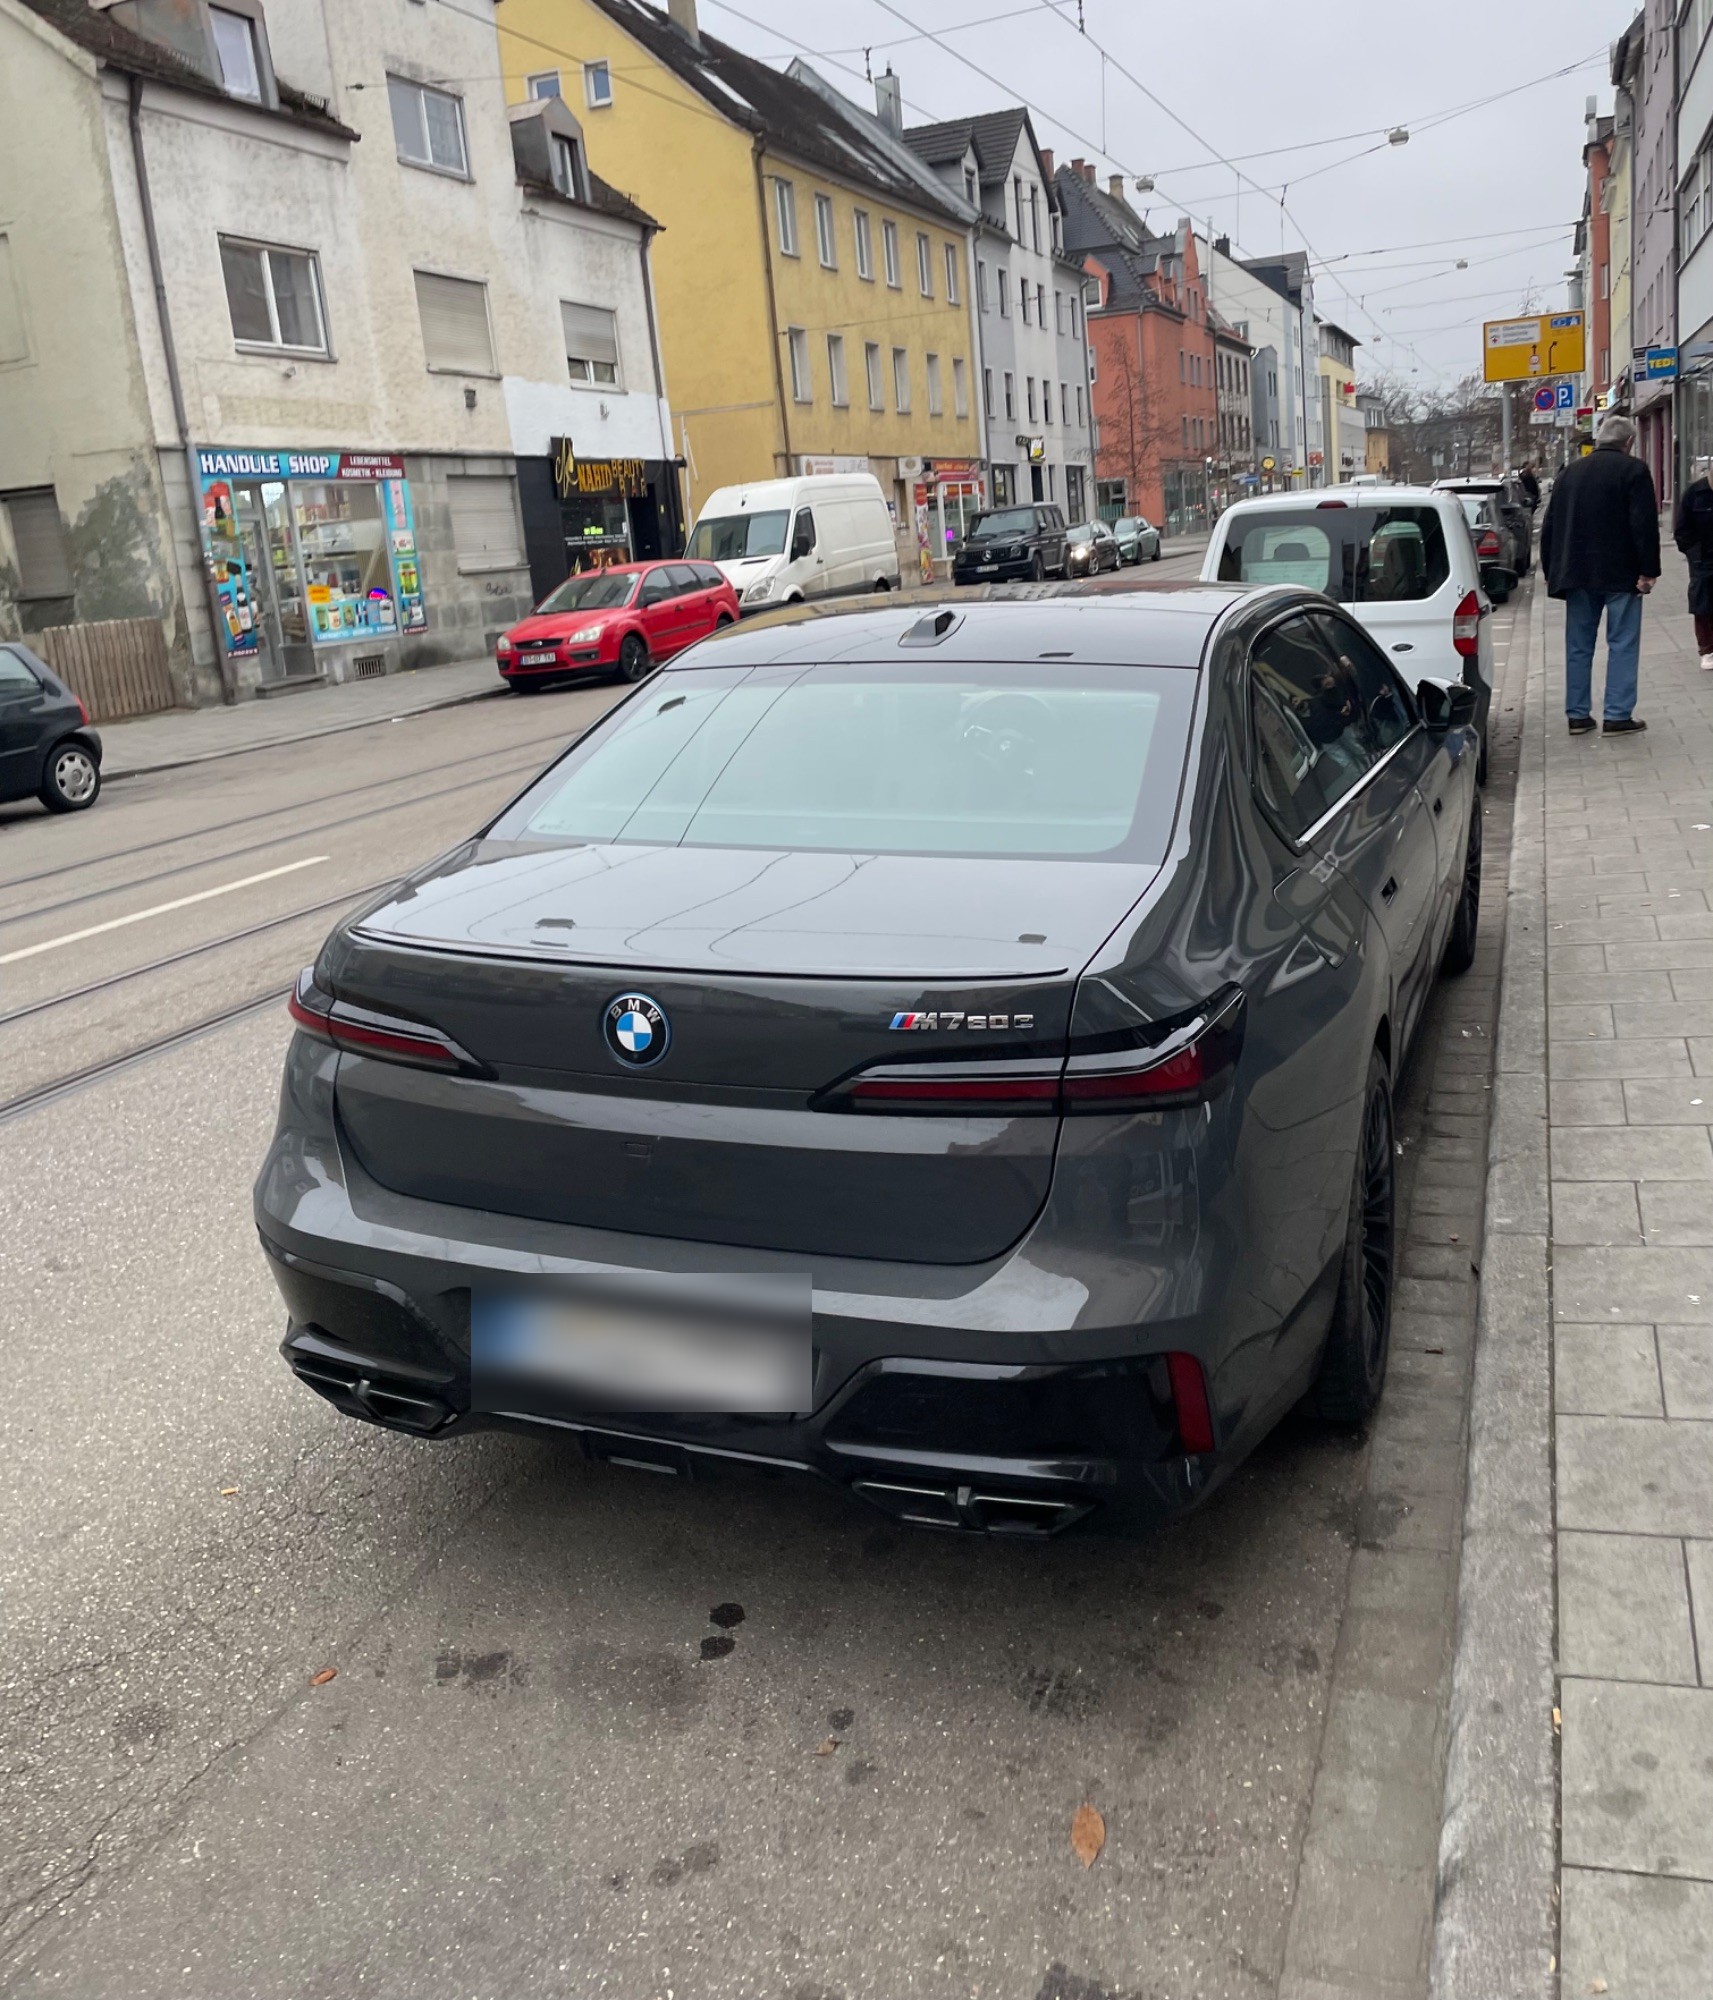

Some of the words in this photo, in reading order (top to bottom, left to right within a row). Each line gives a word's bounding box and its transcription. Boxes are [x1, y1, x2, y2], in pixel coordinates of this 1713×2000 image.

[201, 454, 280, 474] HANDULE
[289, 456, 330, 473] SHOP
[611, 458, 645, 478] BEAUTY
[577, 463, 613, 492] NAHID
[610, 999, 661, 1024] BMW
